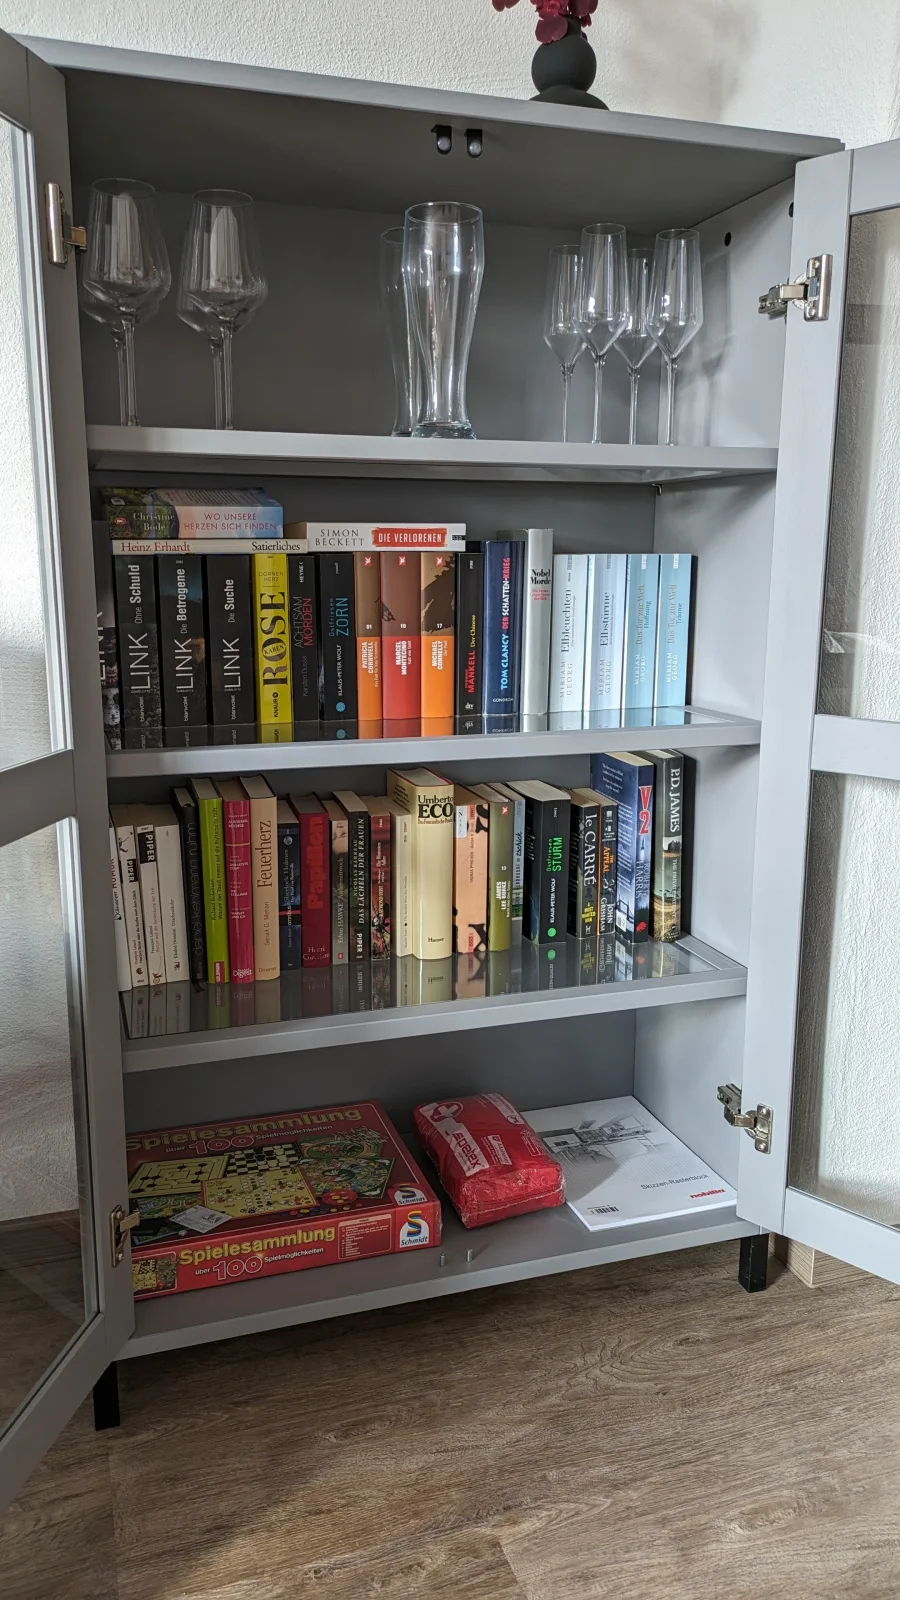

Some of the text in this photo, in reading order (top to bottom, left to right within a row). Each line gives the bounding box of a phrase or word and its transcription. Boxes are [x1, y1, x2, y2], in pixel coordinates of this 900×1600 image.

[133, 512, 174, 520] Christine
[144, 522, 165, 530] Bode
[184, 522, 277, 530] HERZEN SICH FINDEN
[121, 541, 190, 551] Heinz Erhardt
[252, 541, 300, 551] Satierliches
[315, 538, 365, 546] BECKETT
[320, 529, 359, 537] SIMON
[378, 533, 391, 543] DIE
[394, 533, 442, 543] VERLORENEN
[502, 557, 511, 616] SCHATTEN-KRIEG
[530, 577, 551, 585] Morde
[532, 568, 550, 577] Nobel
[128, 564, 142, 624] Ohne Schuld
[177, 568, 189, 621] Betrogene
[224, 579, 234, 610] Suche
[293, 596, 303, 648] ACHTSAM
[303, 598, 312, 646] MORDEN
[336, 597, 349, 636] ZORN
[561, 589, 572, 652] Elbleuchten
[600, 592, 610, 646] Elbstürme
[260, 591, 288, 686] ROSE
[128, 632, 150, 689] LINK
[174, 638, 194, 689] LINK
[222, 637, 241, 688] LINK
[418, 795, 453, 804] Umberto
[418, 803, 453, 818] ECO
[669, 768, 680, 832] P.D. JAMES
[145, 832, 154, 862] PIPER
[256, 820, 272, 888] Feuerherz
[306, 816, 324, 910] Papillon
[552, 837, 562, 872] STURM
[583, 814, 597, 886] le CARRÉ
[186, 822, 204, 955] daniel kehlmann ruhm
[607, 904, 615, 924] JOHN
[126, 1109, 362, 1150] Spielesammlung
[189, 1135, 254, 1154] 100
[641, 1173, 709, 1190] Skizzen-Rasterblock
[690, 1188, 726, 1199] nobilia
[398, 1196, 427, 1204] Schmidt
[179, 1225, 336, 1266] Spielesammlung
[401, 1236, 428, 1246] Schmidt
[195, 1248, 324, 1280] über 100 Spielmöglichkeiten
